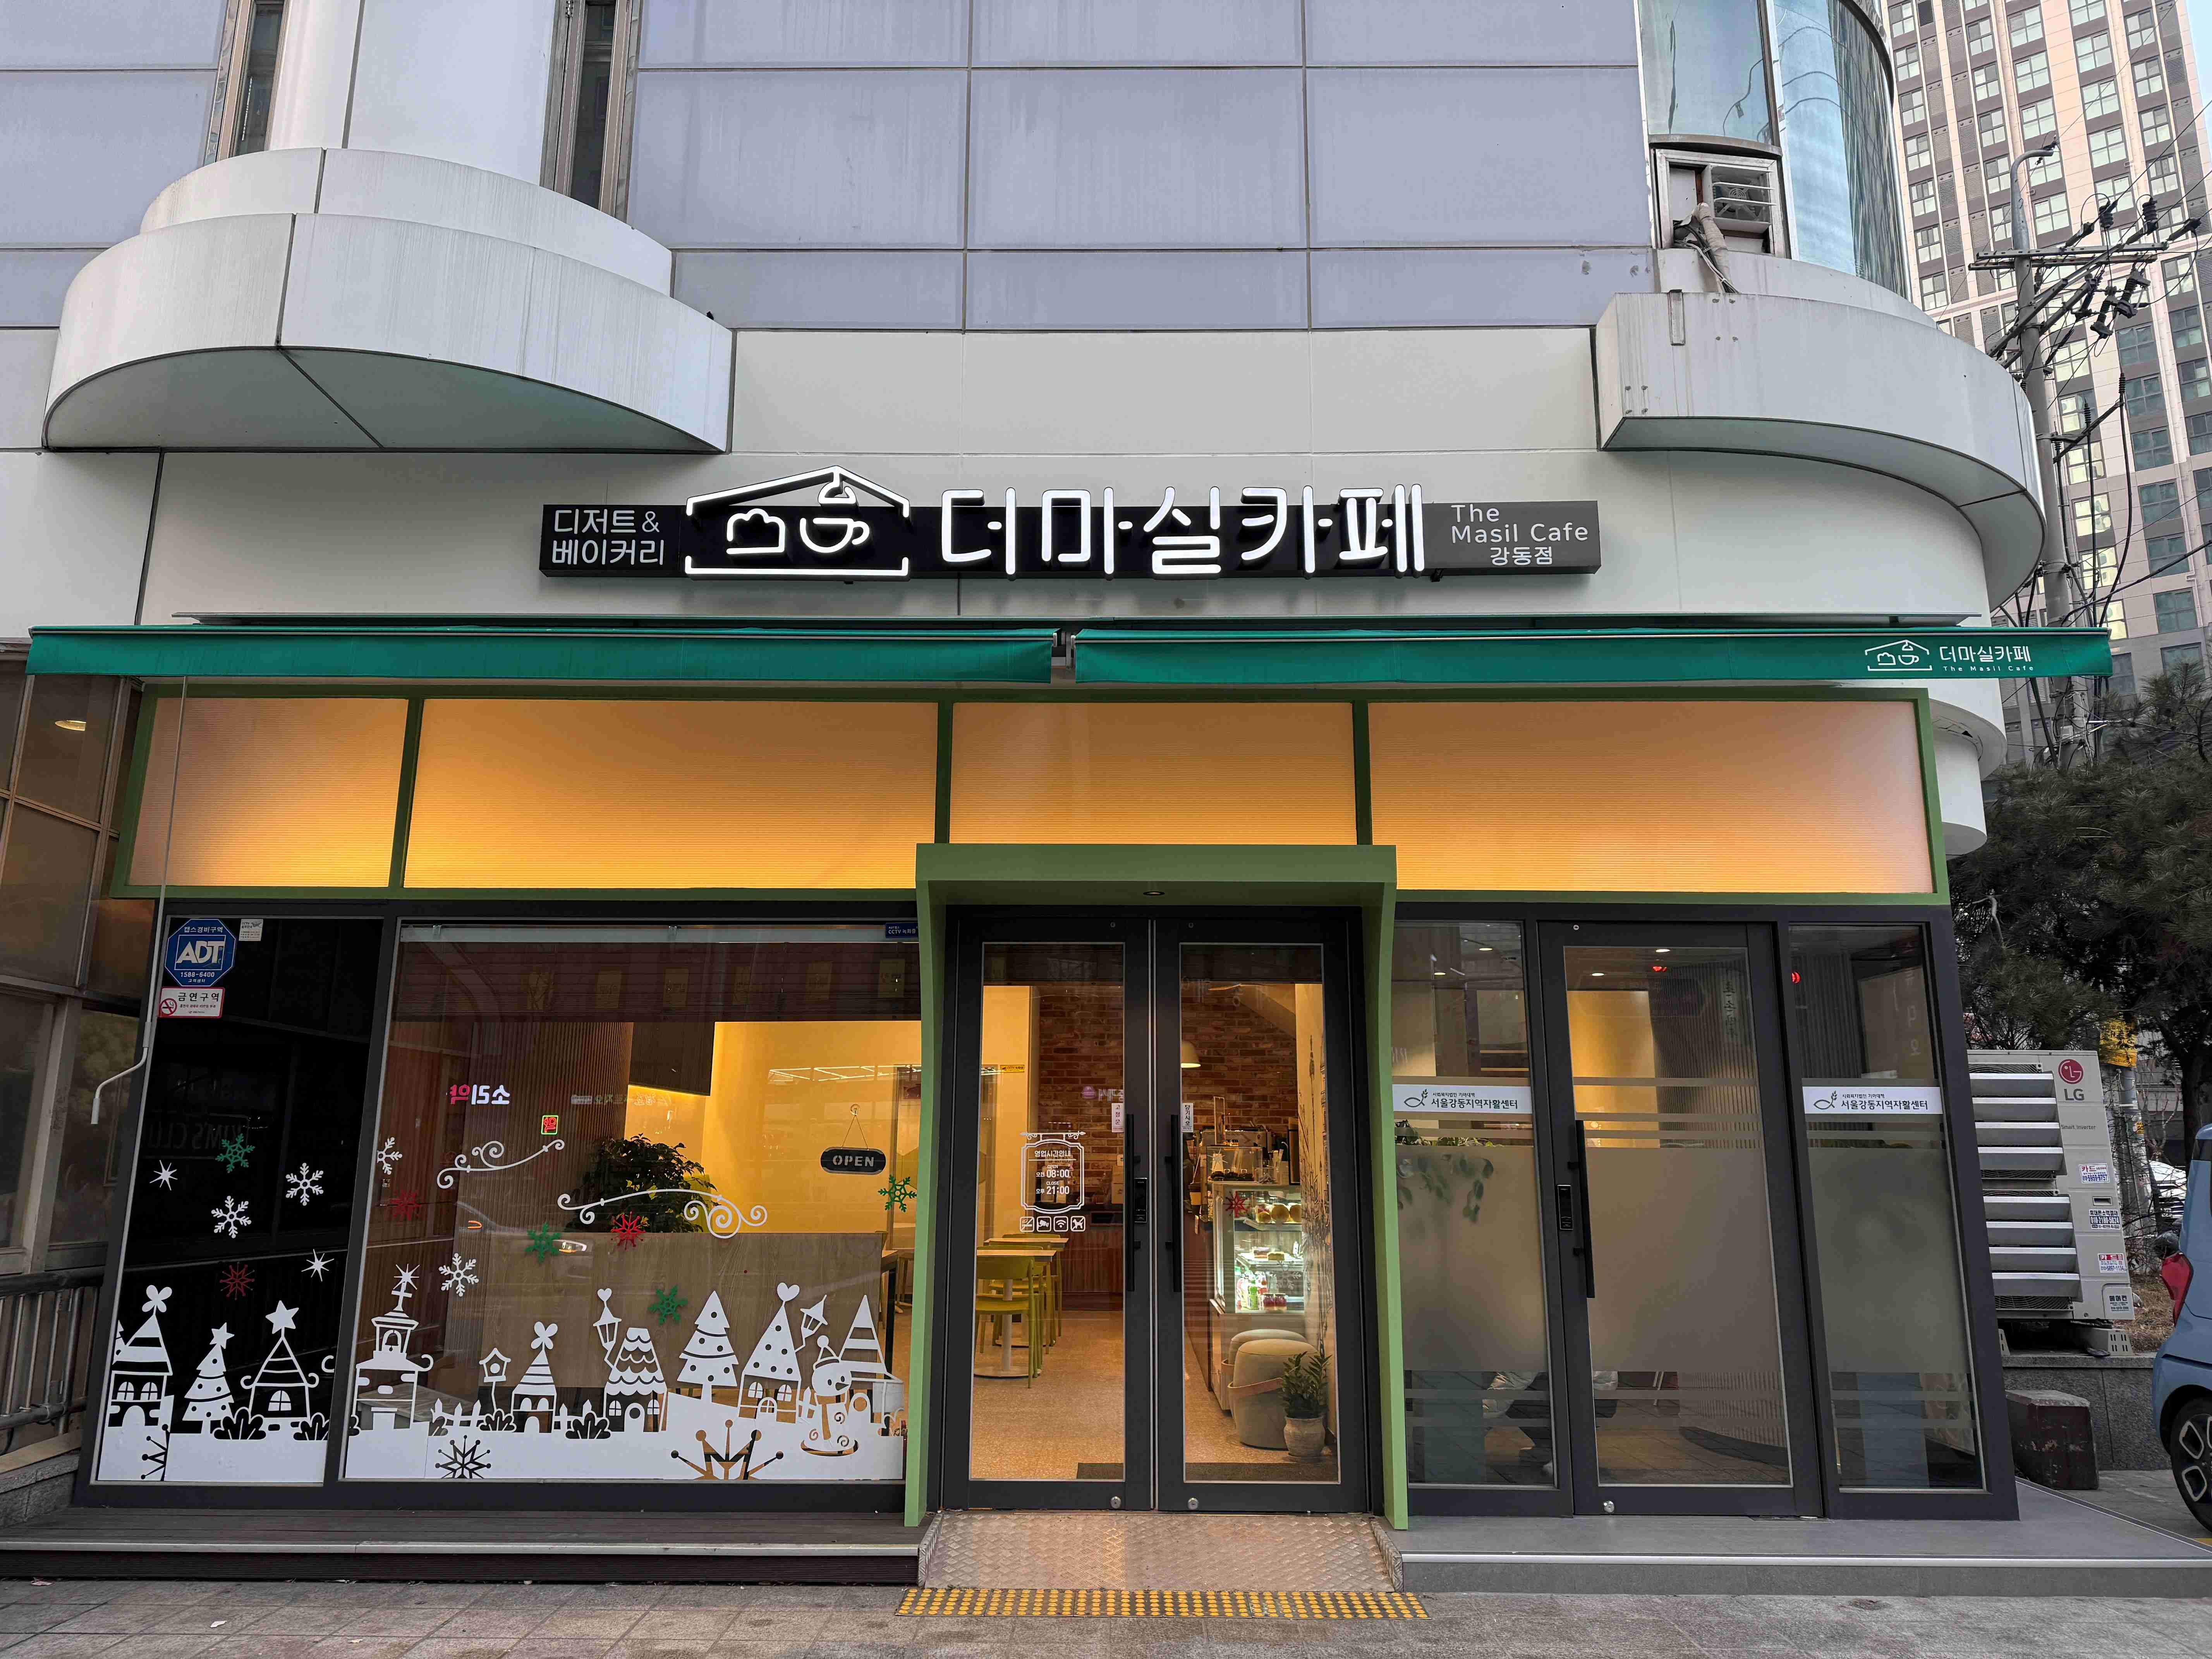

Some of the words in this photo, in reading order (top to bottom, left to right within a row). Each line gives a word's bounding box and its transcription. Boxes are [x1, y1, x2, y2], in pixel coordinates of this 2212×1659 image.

[1451, 505, 1500, 523] The
[941, 484, 1425, 576] 더마실카페
[1451, 524, 1519, 543] Masil
[1530, 523, 1589, 543] Cafe
[551, 538, 664, 565] 베이커리
[1490, 546, 1553, 565] 강동점
[1939, 646, 2032, 663] 더마실카페
[176, 940, 226, 963] ADT
[1431, 1097, 1518, 1109] 서울강동지역자활센터
[2063, 1088, 2085, 1101] LG
[1841, 1100, 1928, 1110] 서울강동지역자활센터
[832, 1155, 874, 1166] OPEN
[1046, 1169, 1070, 1178] 08:00
[1046, 1186, 1070, 1195] 21:00
